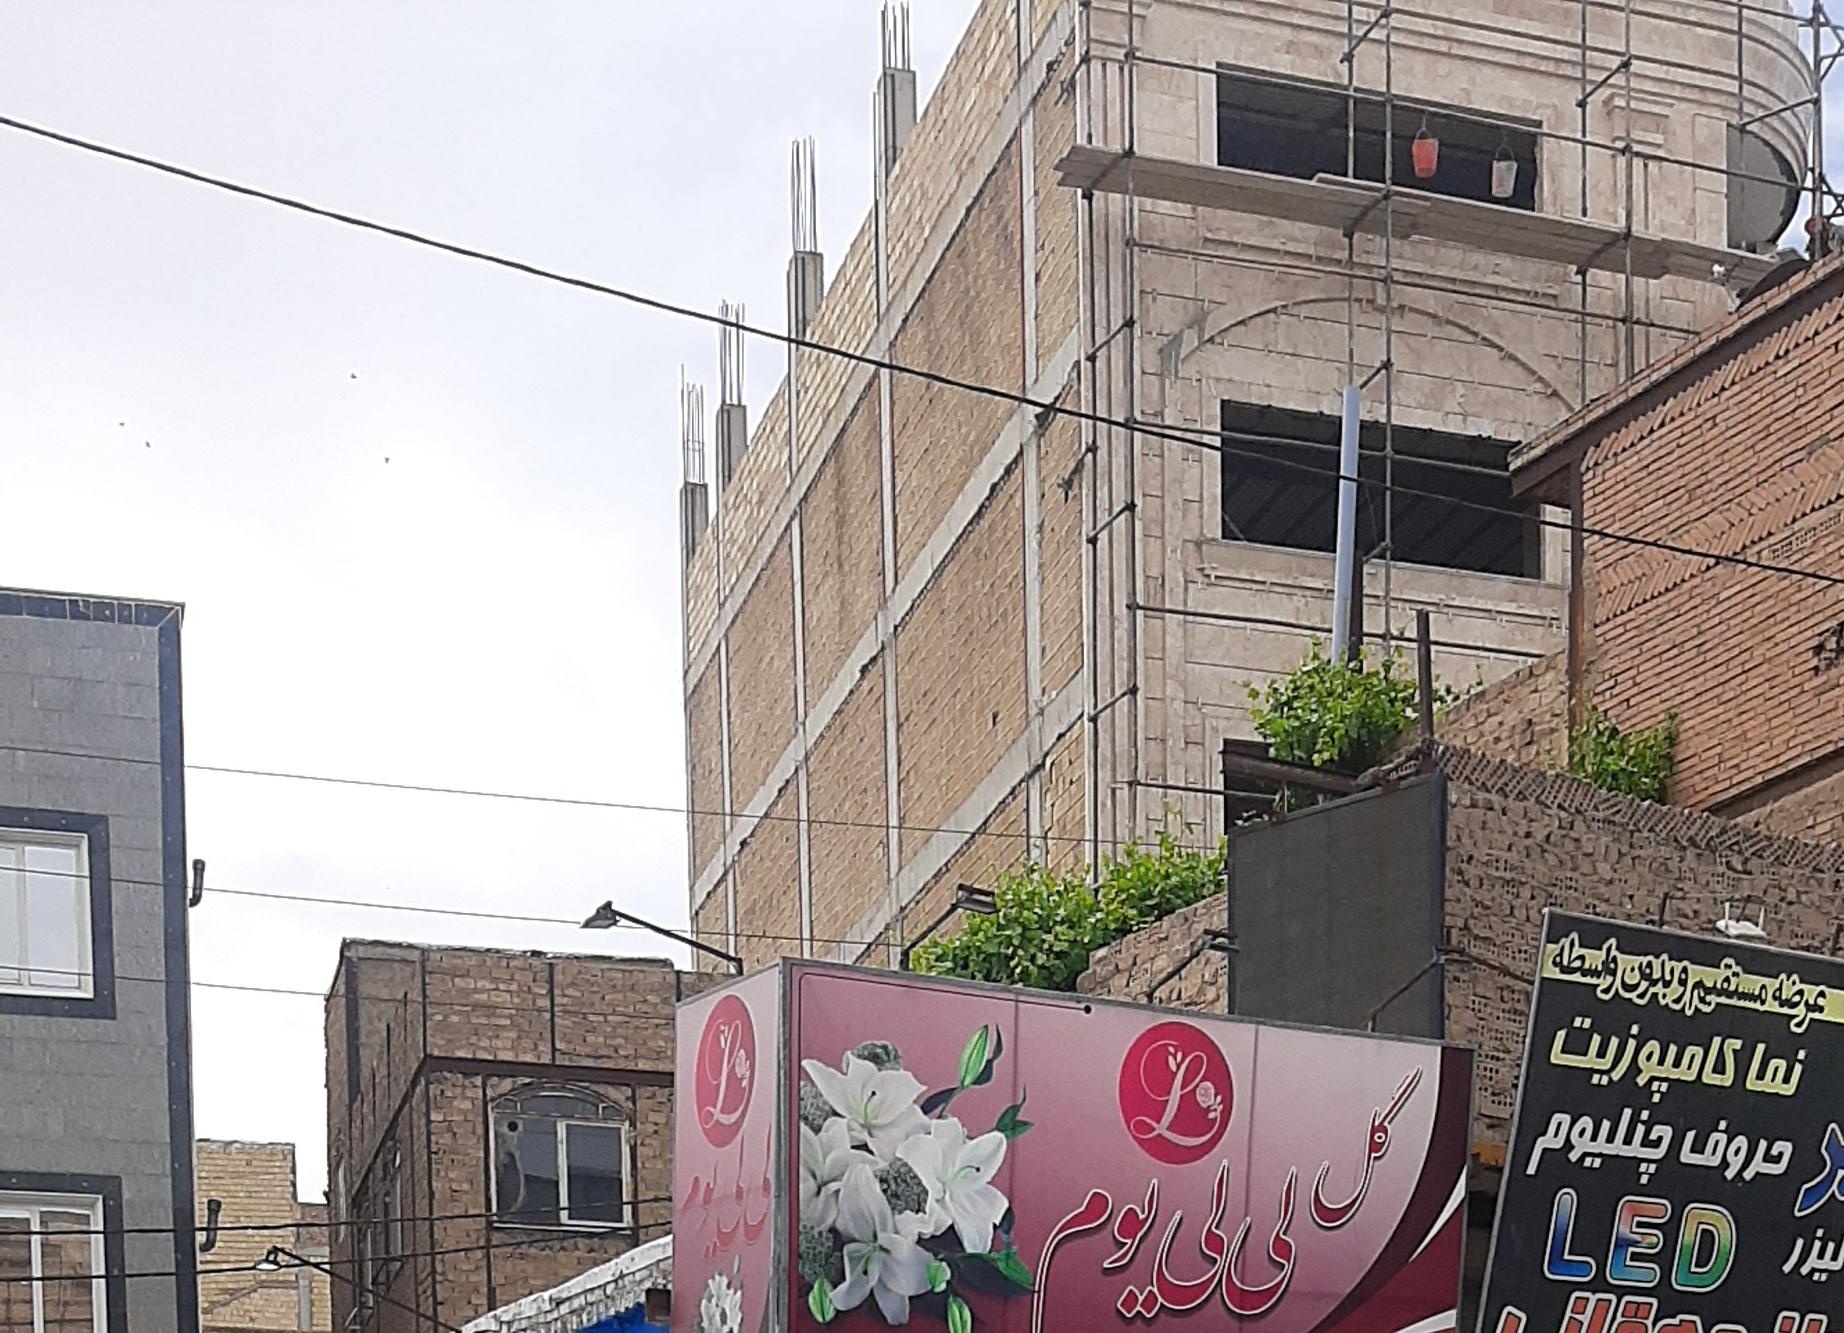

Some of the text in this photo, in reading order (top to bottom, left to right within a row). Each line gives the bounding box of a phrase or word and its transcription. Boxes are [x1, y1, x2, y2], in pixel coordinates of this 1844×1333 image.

[1552, 932, 1827, 1032] عرضه مستقیم و بدون واسطه
[1550, 1017, 1806, 1102] نما کامپوزیت
[1310, 1066, 1422, 1228] گل
[1526, 1108, 1673, 1184] چنلیوم
[1679, 1120, 1792, 1181] حروف
[1153, 1159, 1228, 1309] لی
[1222, 1166, 1296, 1314] لی
[1544, 1188, 1735, 1292] LED
